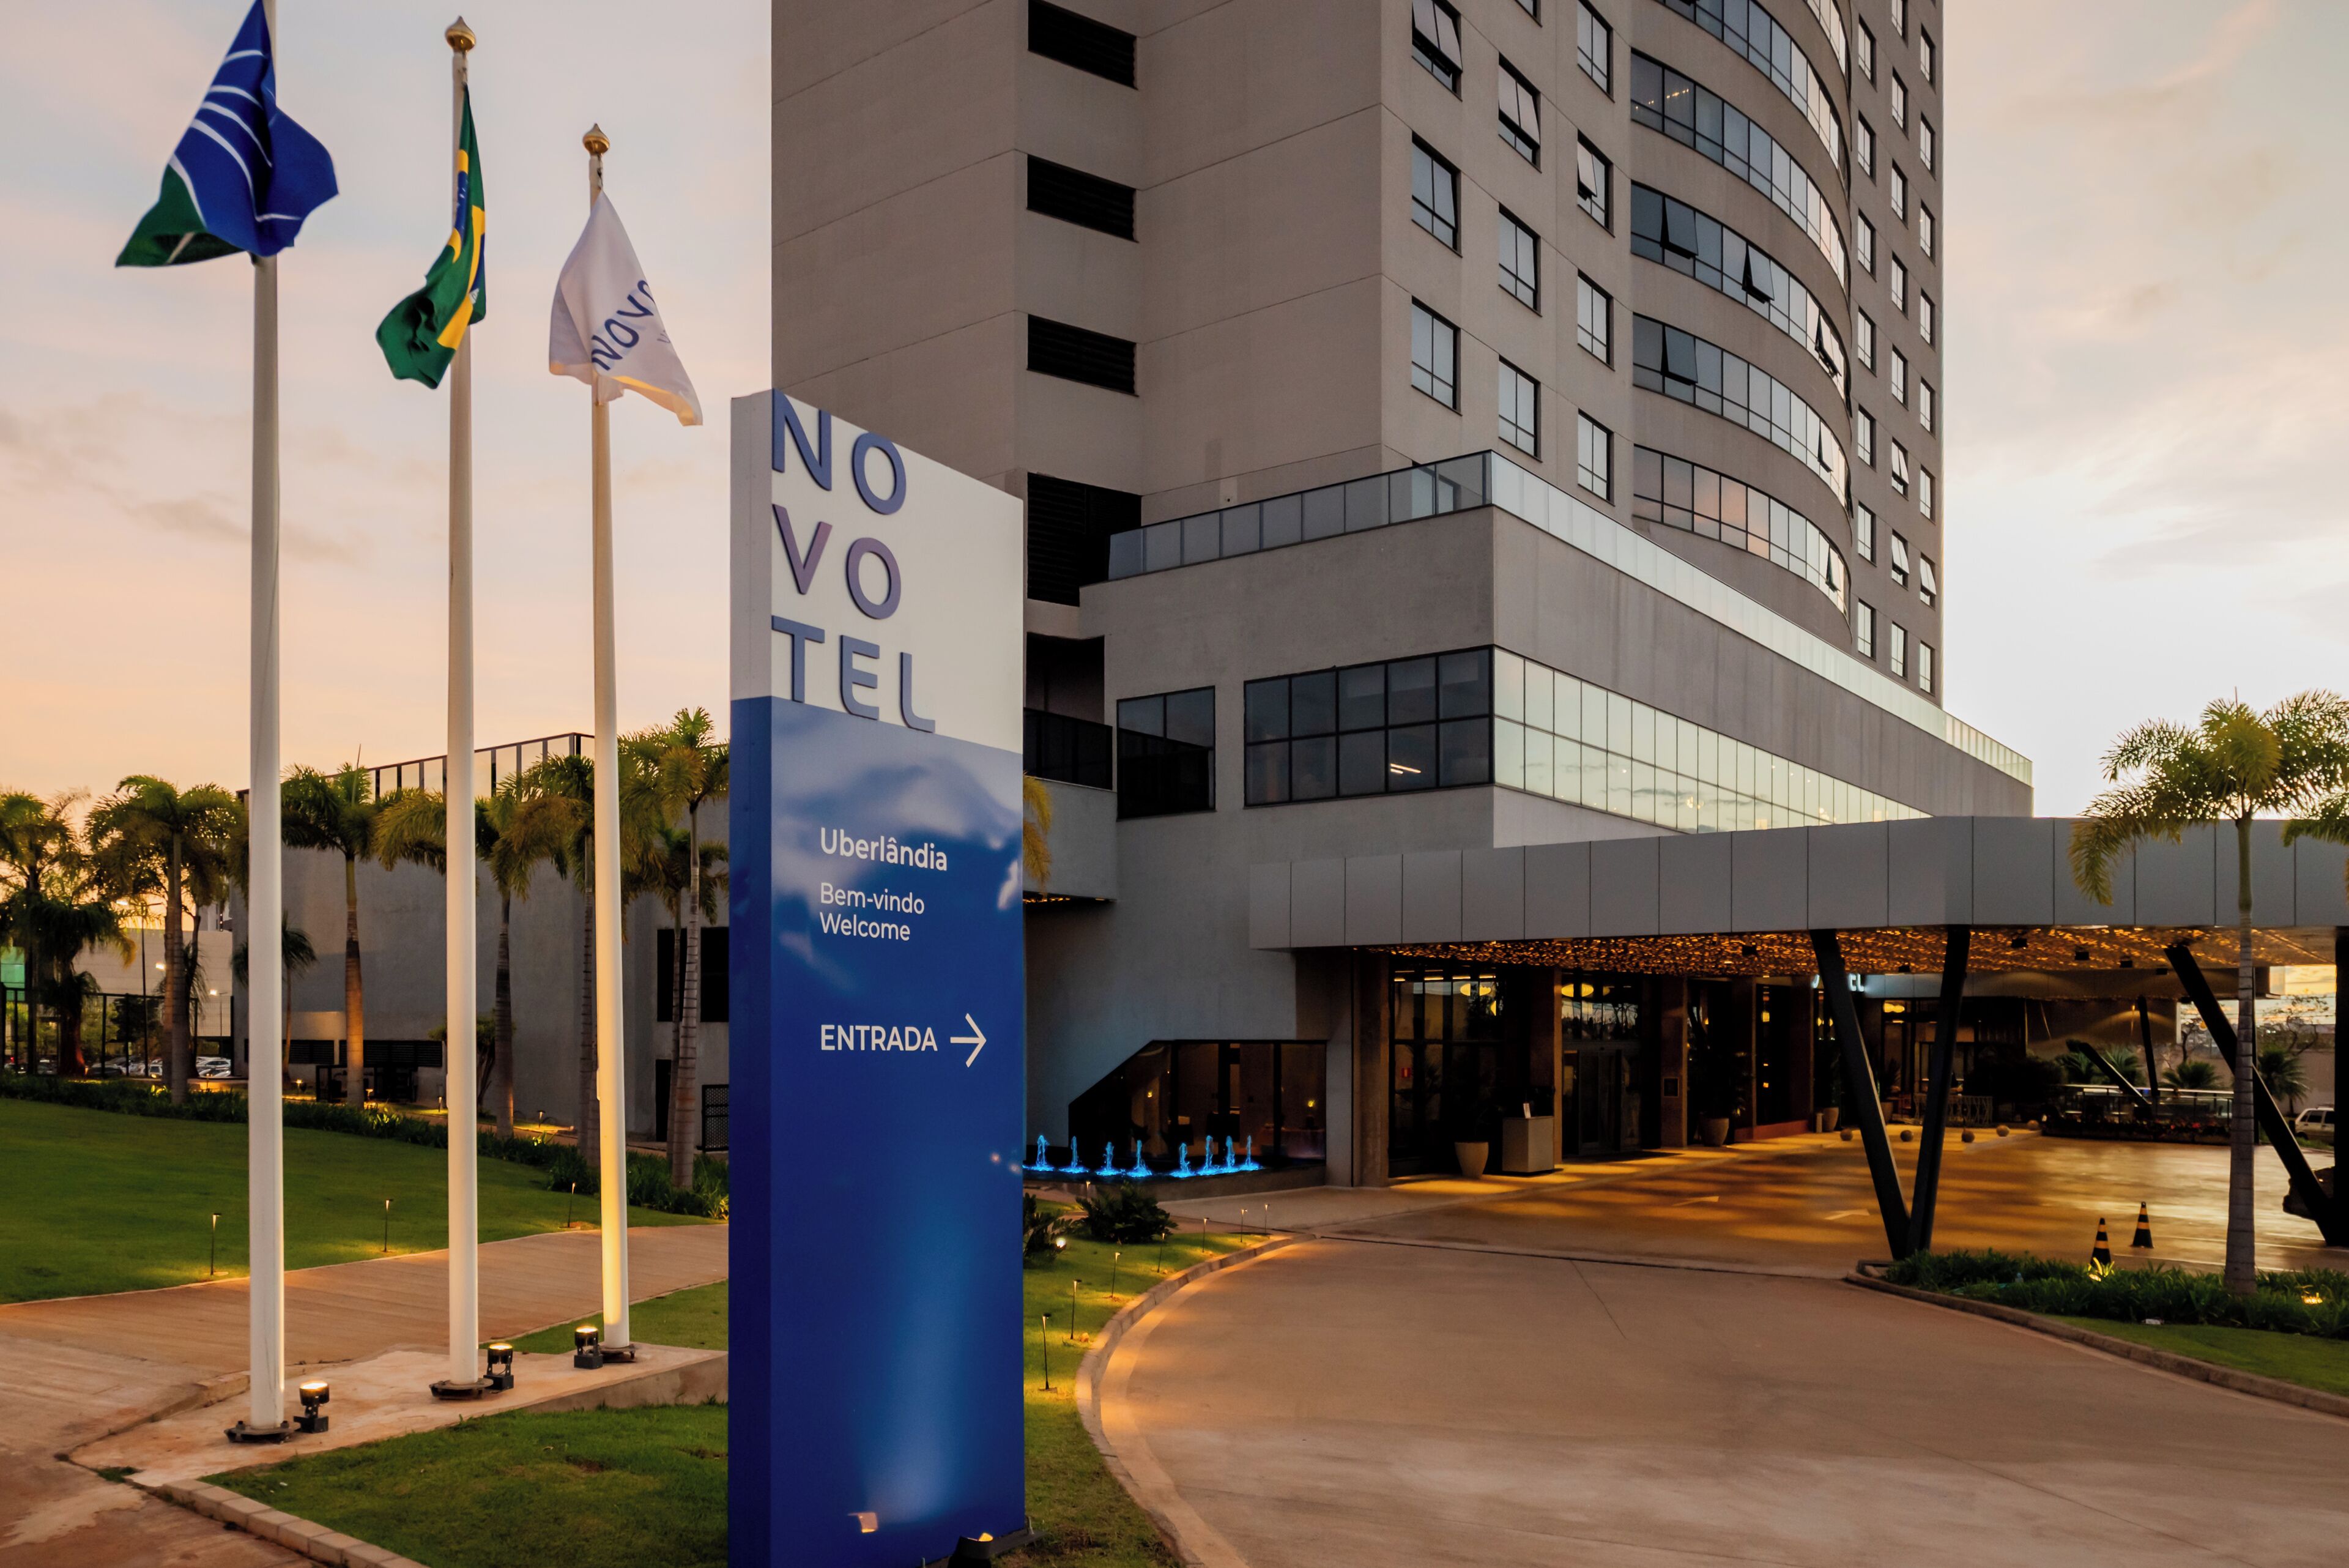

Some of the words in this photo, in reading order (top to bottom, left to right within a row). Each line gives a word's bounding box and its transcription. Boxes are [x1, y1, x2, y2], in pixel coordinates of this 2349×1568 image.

[772, 388, 907, 515] NO
[772, 503, 902, 620] VO
[771, 615, 935, 733] TEL
[820, 827, 948, 871] Uberlândia
[820, 882, 924, 914] Bem-vindo
[820, 912, 910, 941] Welcome
[820, 1024, 938, 1052] ENTRADA
